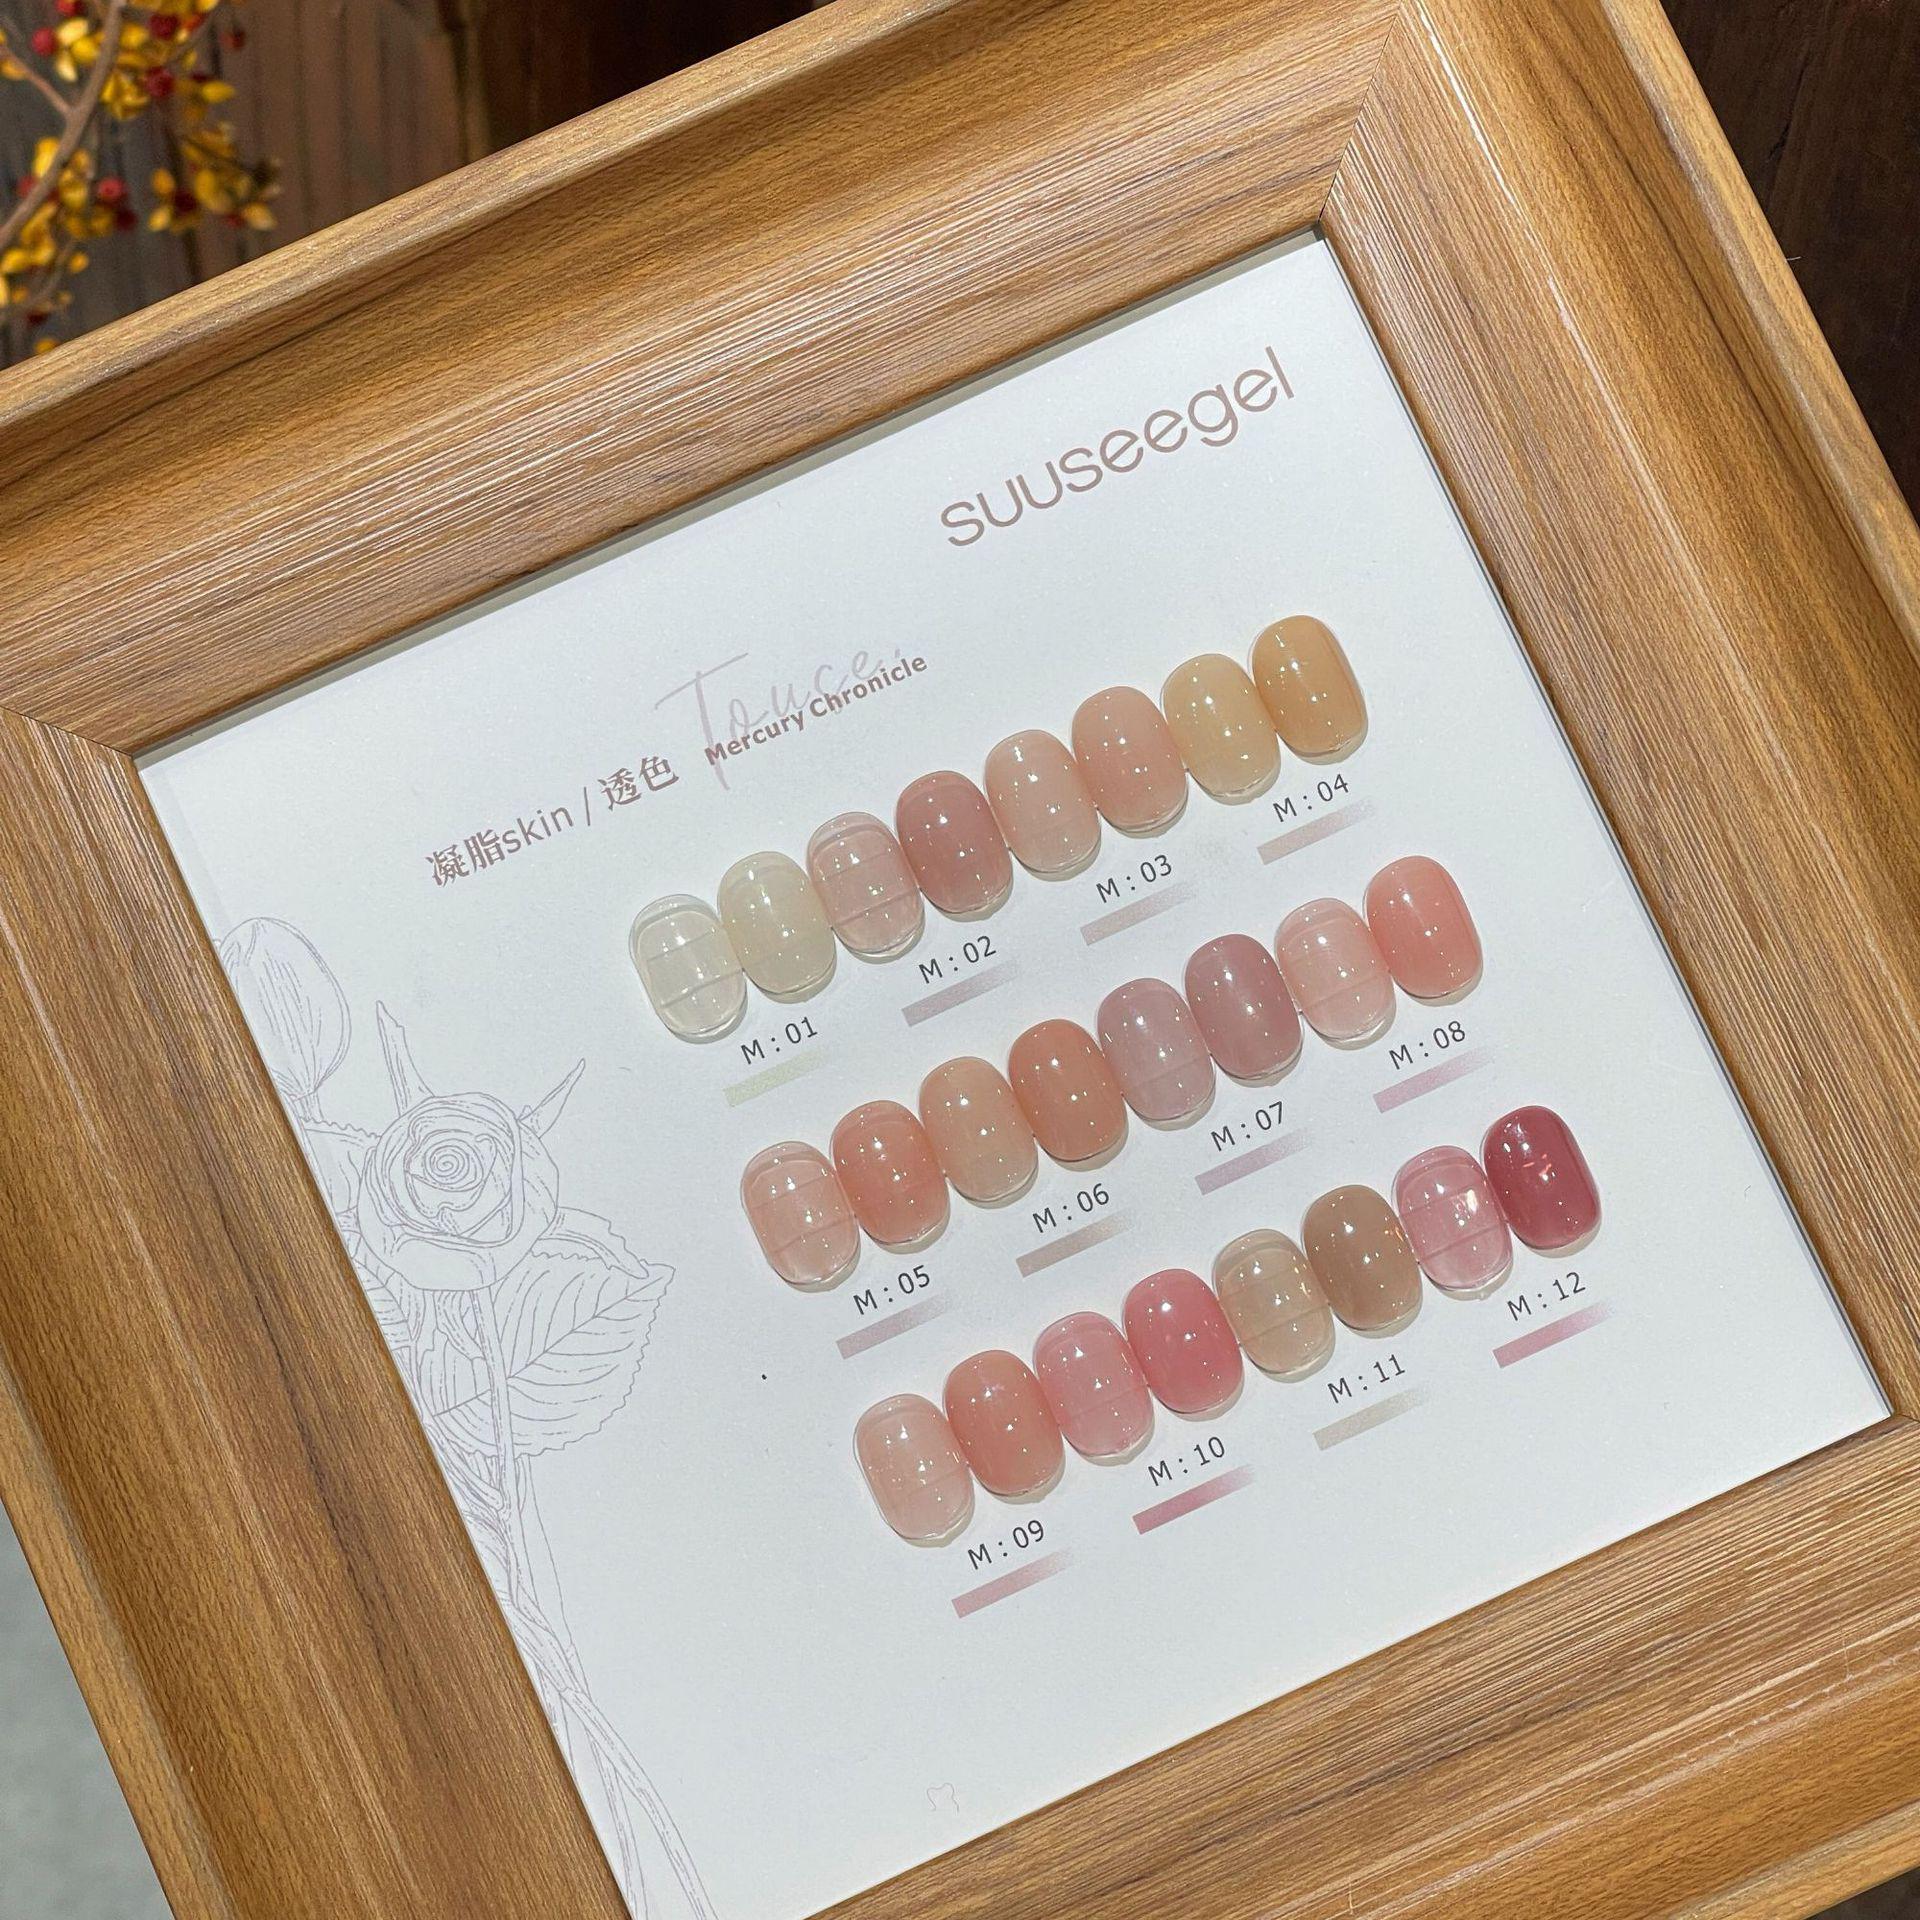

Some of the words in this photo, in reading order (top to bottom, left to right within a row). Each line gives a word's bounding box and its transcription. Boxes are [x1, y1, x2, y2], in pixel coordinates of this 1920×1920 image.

[940, 346, 1295, 547] suuseegel
[704, 710, 805, 766] Mercury
[809, 656, 928, 717] Chronicle
[598, 756, 680, 811] 透色
